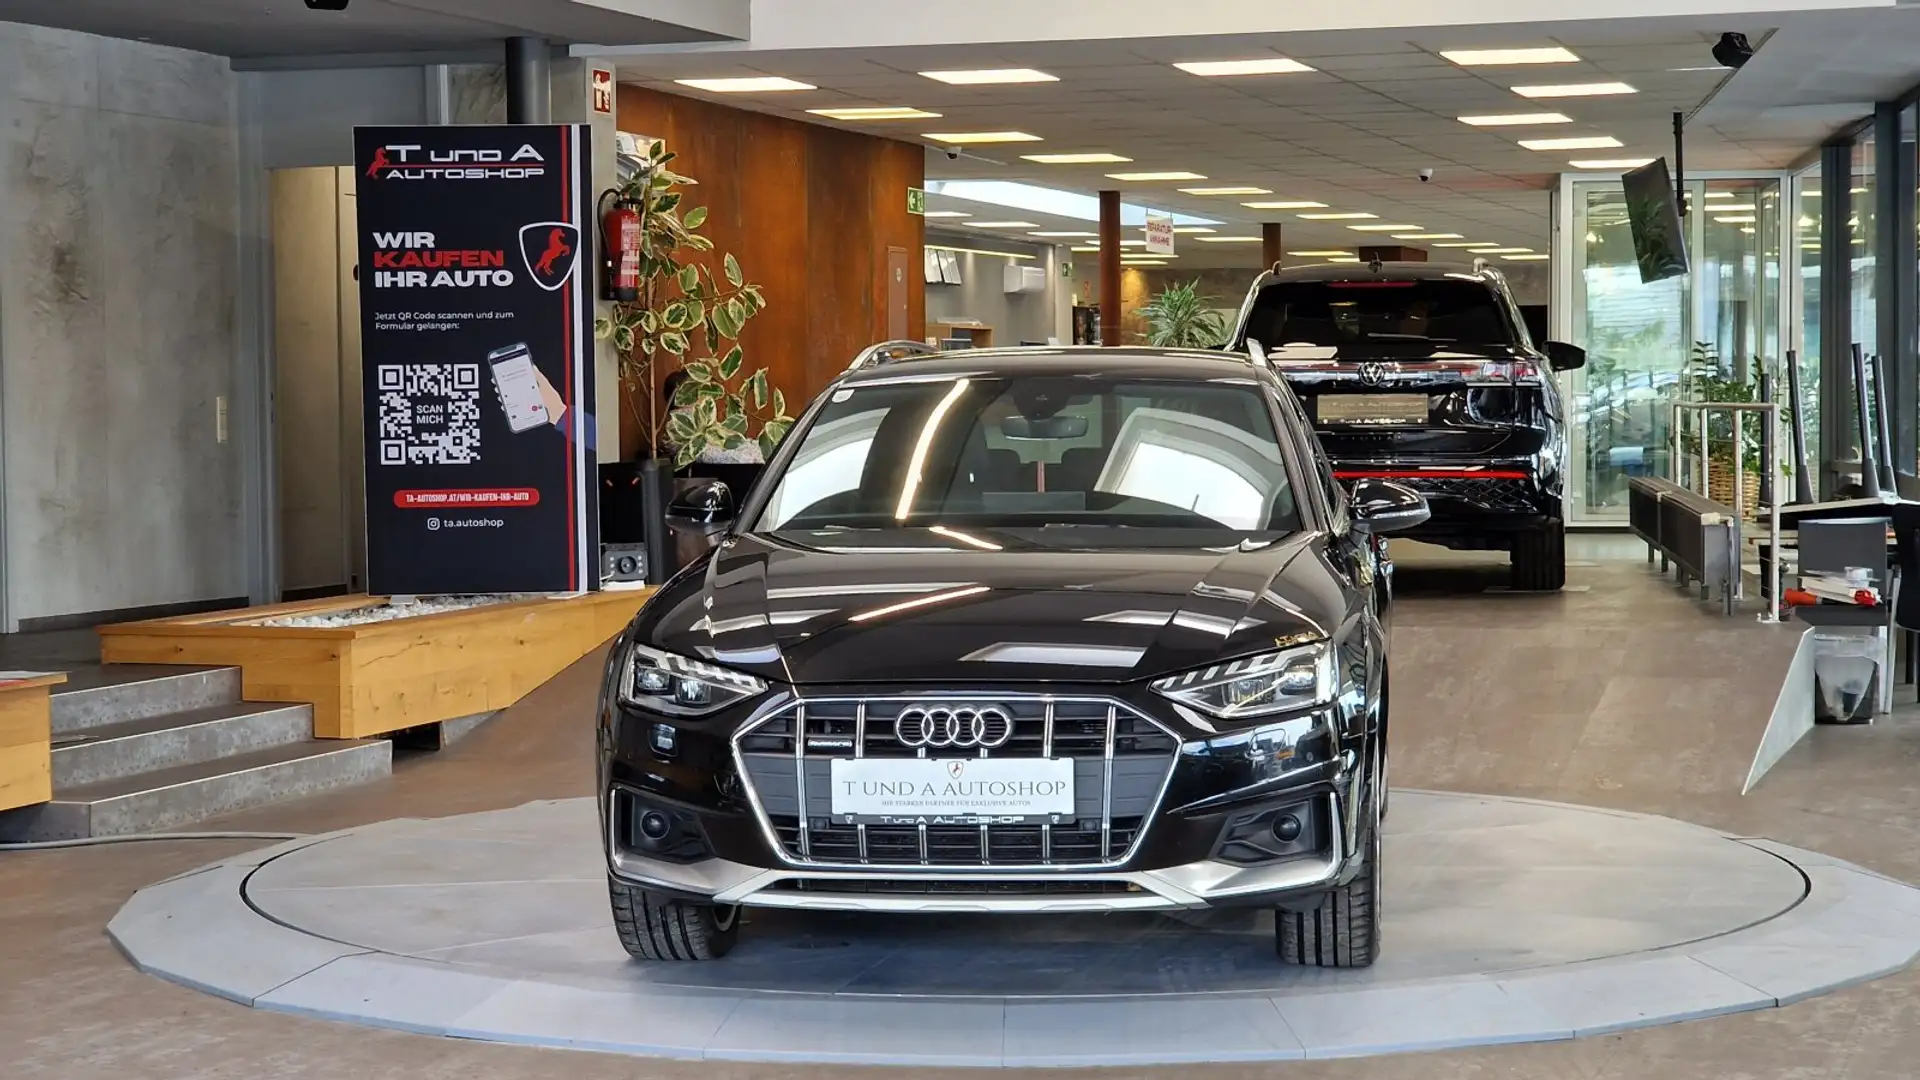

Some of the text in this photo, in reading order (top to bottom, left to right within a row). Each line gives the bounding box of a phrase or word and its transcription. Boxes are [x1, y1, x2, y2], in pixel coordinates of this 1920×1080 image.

[385, 144, 421, 162] T
[510, 143, 545, 162] A
[386, 168, 545, 180] AUTOSHOP
[373, 232, 435, 249] WIR
[373, 250, 505, 268] KAUFEN
[374, 270, 514, 288] IHR AUTO
[375, 312, 396, 322] Jetzt
[398, 312, 412, 321] QR
[413, 311, 436, 321] Code
[437, 312, 474, 320] scannen
[476, 311, 494, 320] und
[375, 322, 460, 332] Formular gelangen:
[416, 404, 443, 414] SCAN
[416, 414, 444, 424] MICH
[443, 518, 504, 528] ta.autoshop
[842, 780, 1067, 796] T UND A AUTOSHOP
[933, 816, 1025, 824] AUTOSHOP
